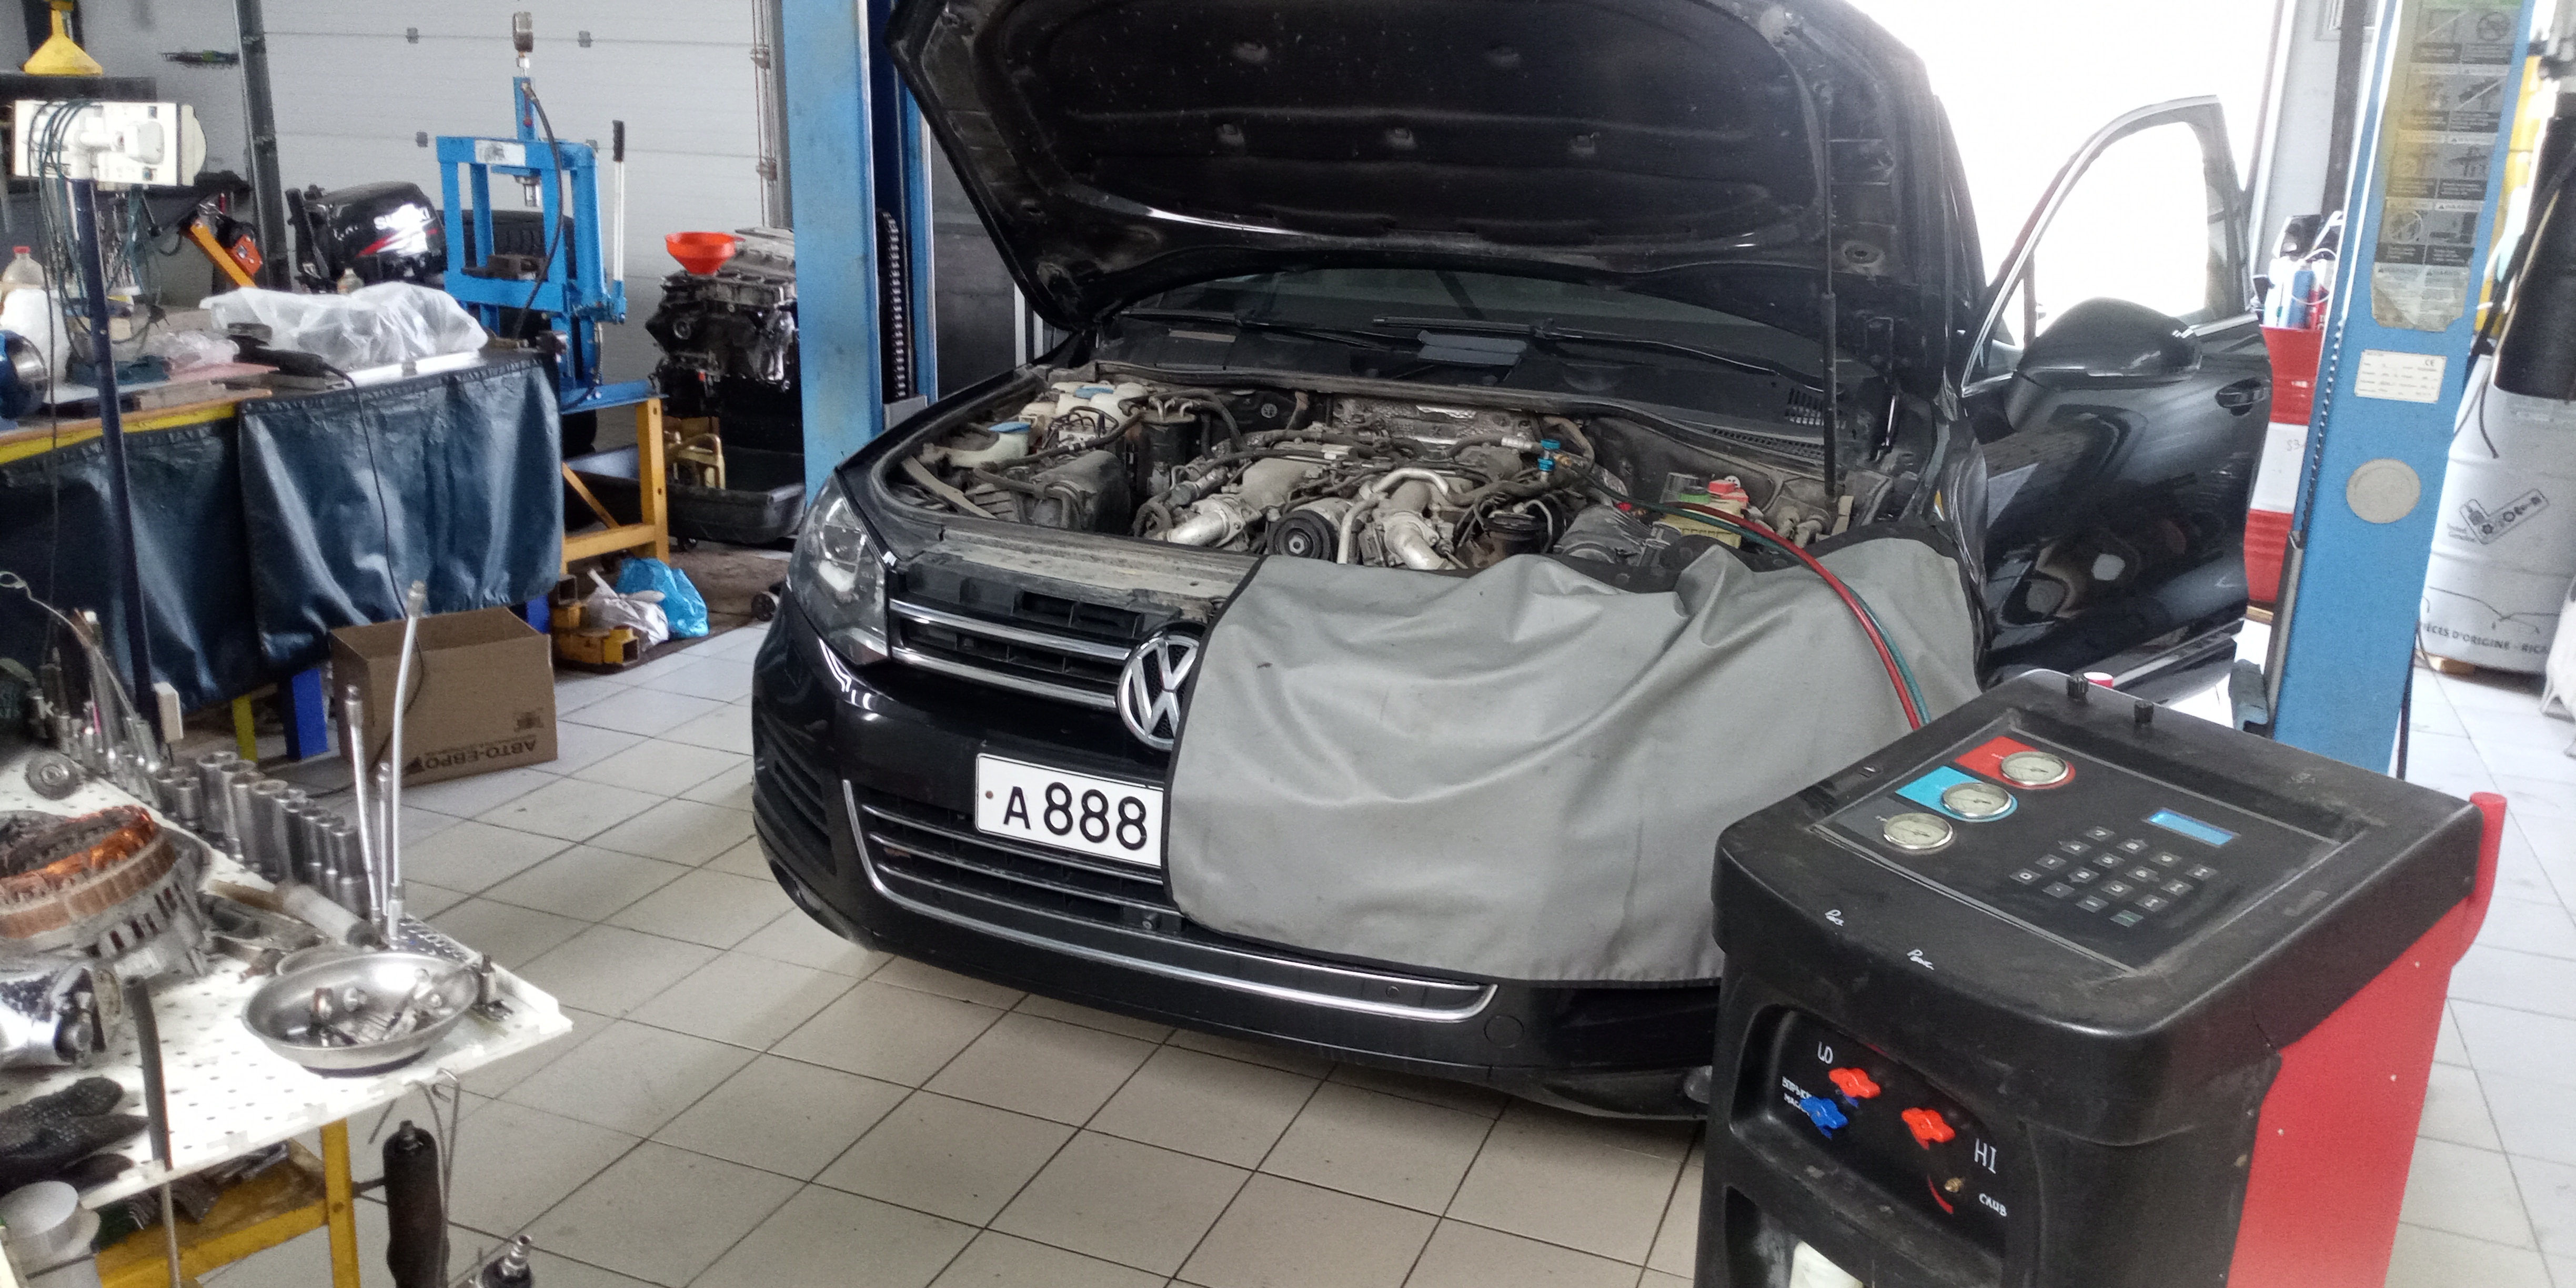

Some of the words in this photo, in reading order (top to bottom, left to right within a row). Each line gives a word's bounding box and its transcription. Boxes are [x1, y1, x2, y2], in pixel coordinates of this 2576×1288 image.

[374, 205, 431, 230] SUKI
[425, 739, 536, 769] АВТО-ЕВРО
[1817, 1041, 1834, 1064] LO
[1974, 1138, 1997, 1174] HI
